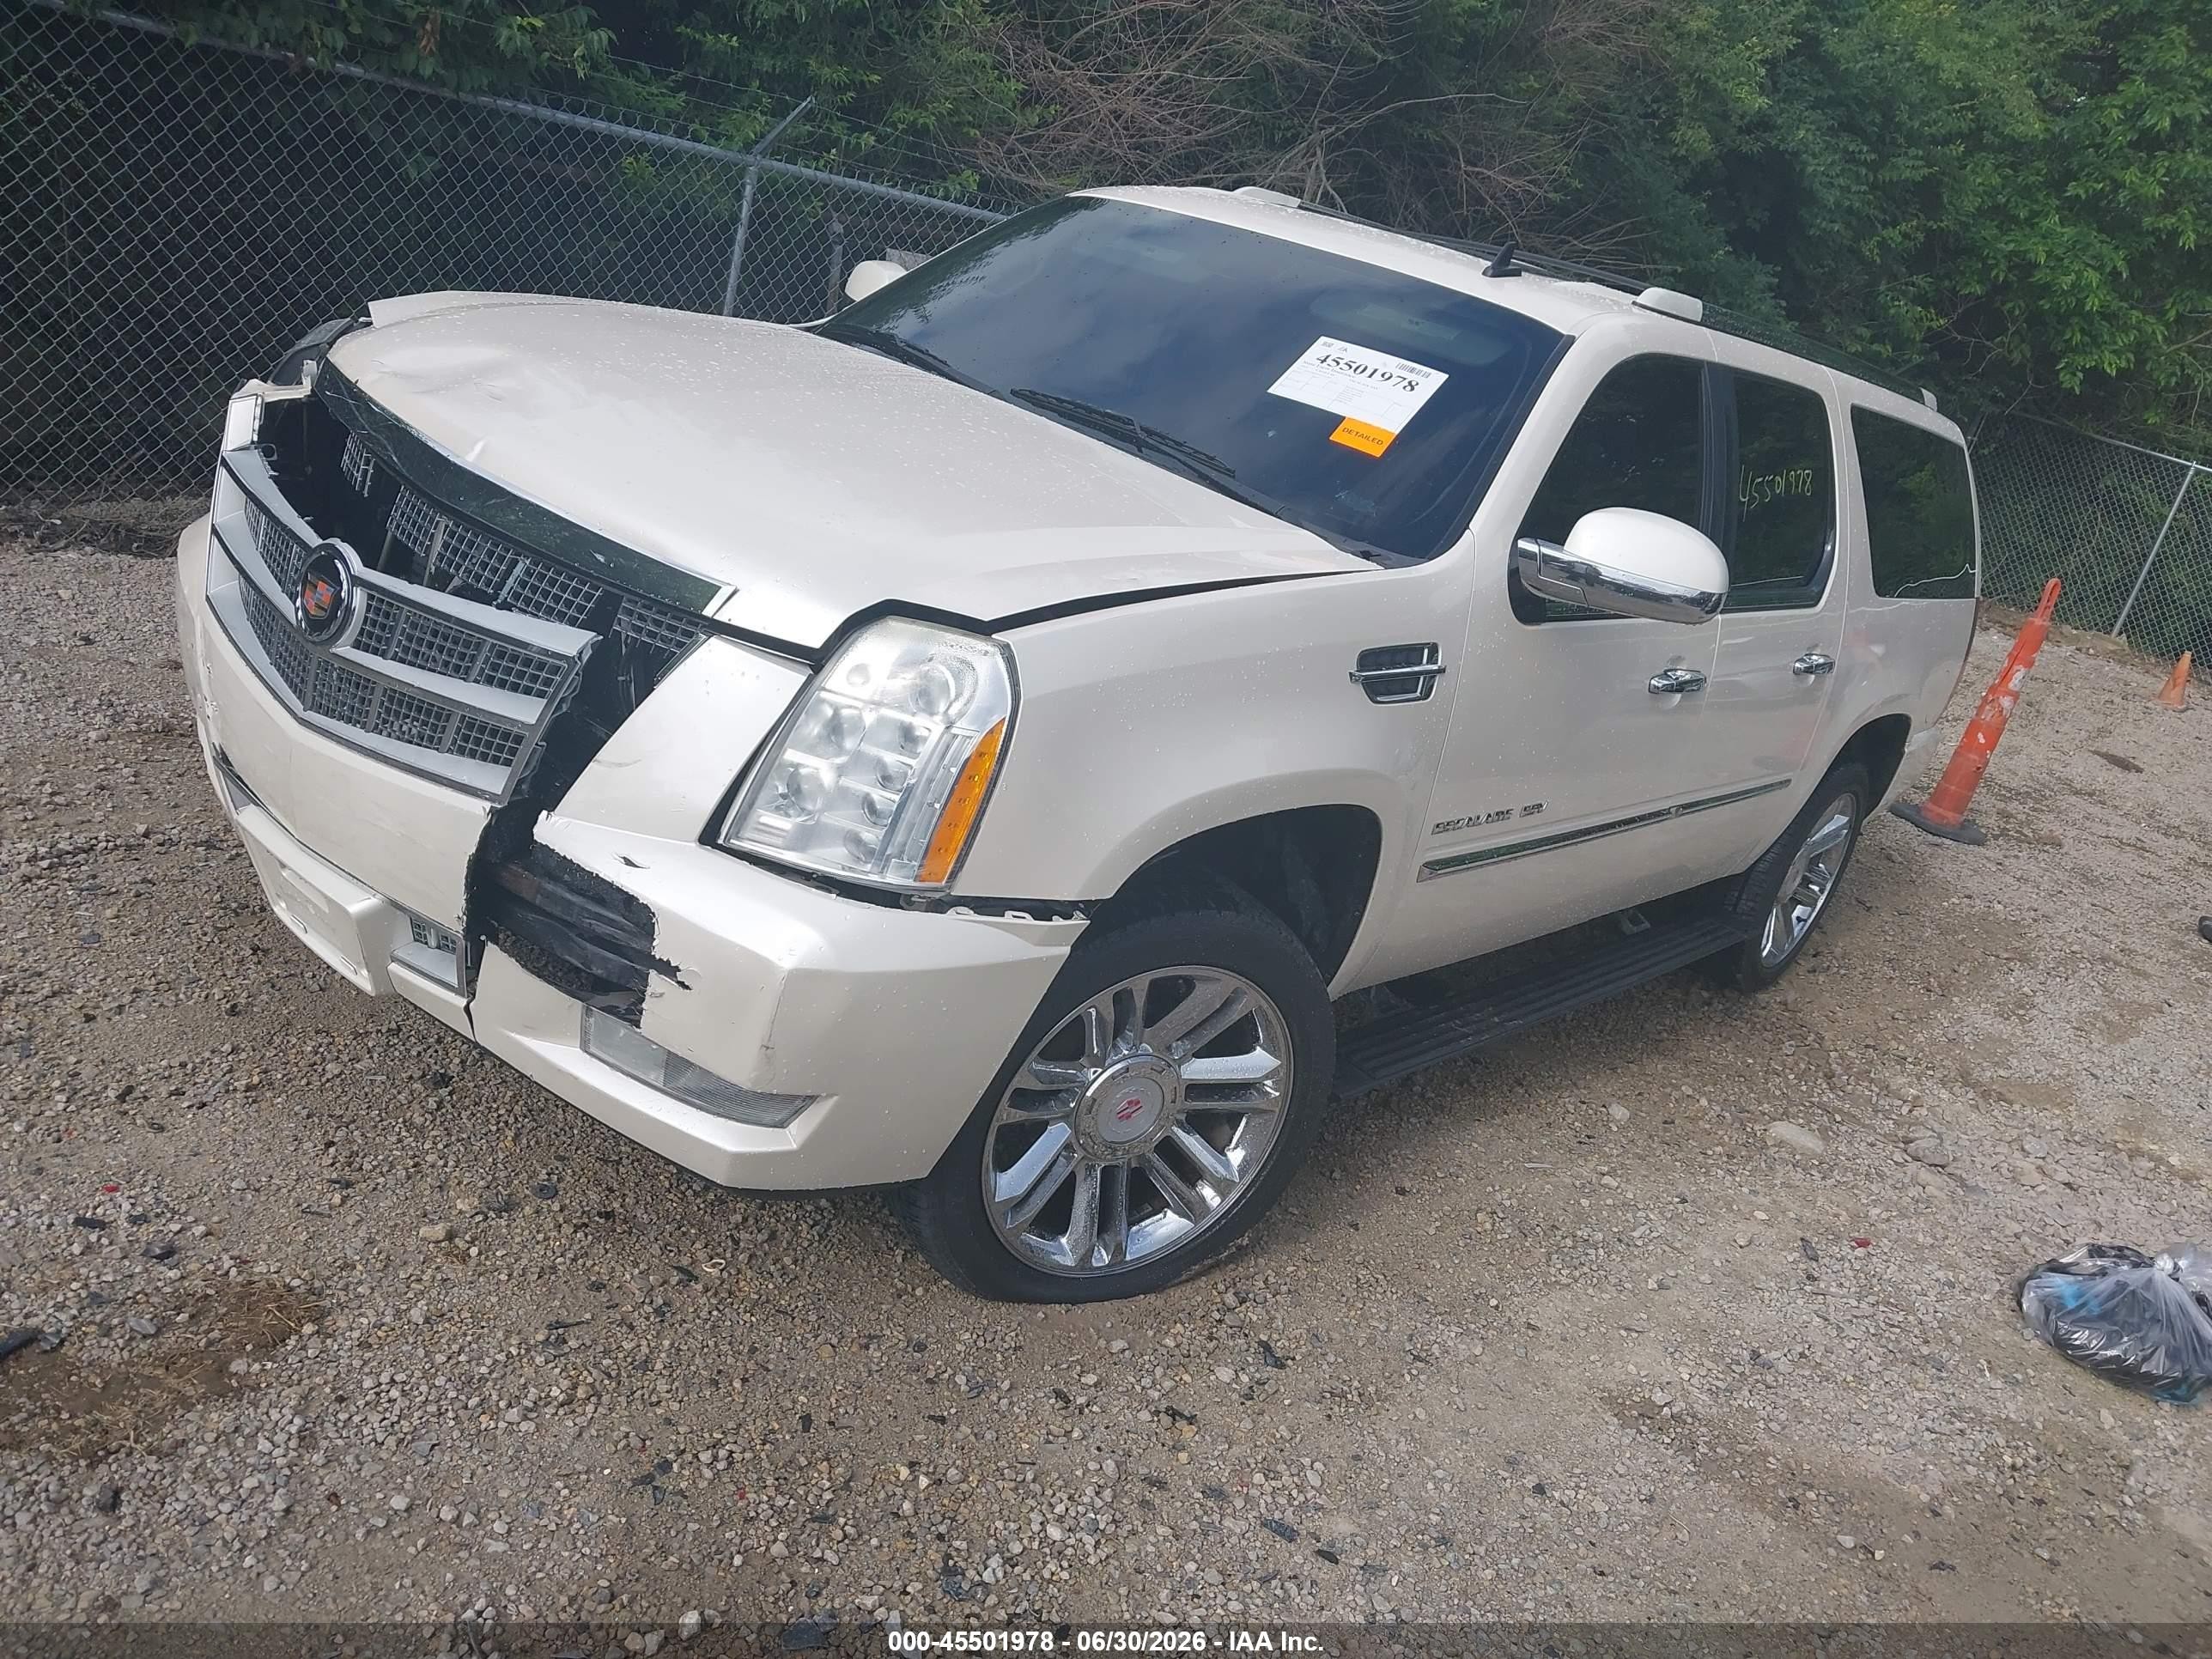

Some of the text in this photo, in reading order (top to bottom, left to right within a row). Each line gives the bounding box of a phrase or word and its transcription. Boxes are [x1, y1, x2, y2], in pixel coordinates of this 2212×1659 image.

[1316, 353, 1420, 392] 45501978
[1341, 427, 1384, 447] DETAILED
[1739, 465, 1813, 522] 45501978
